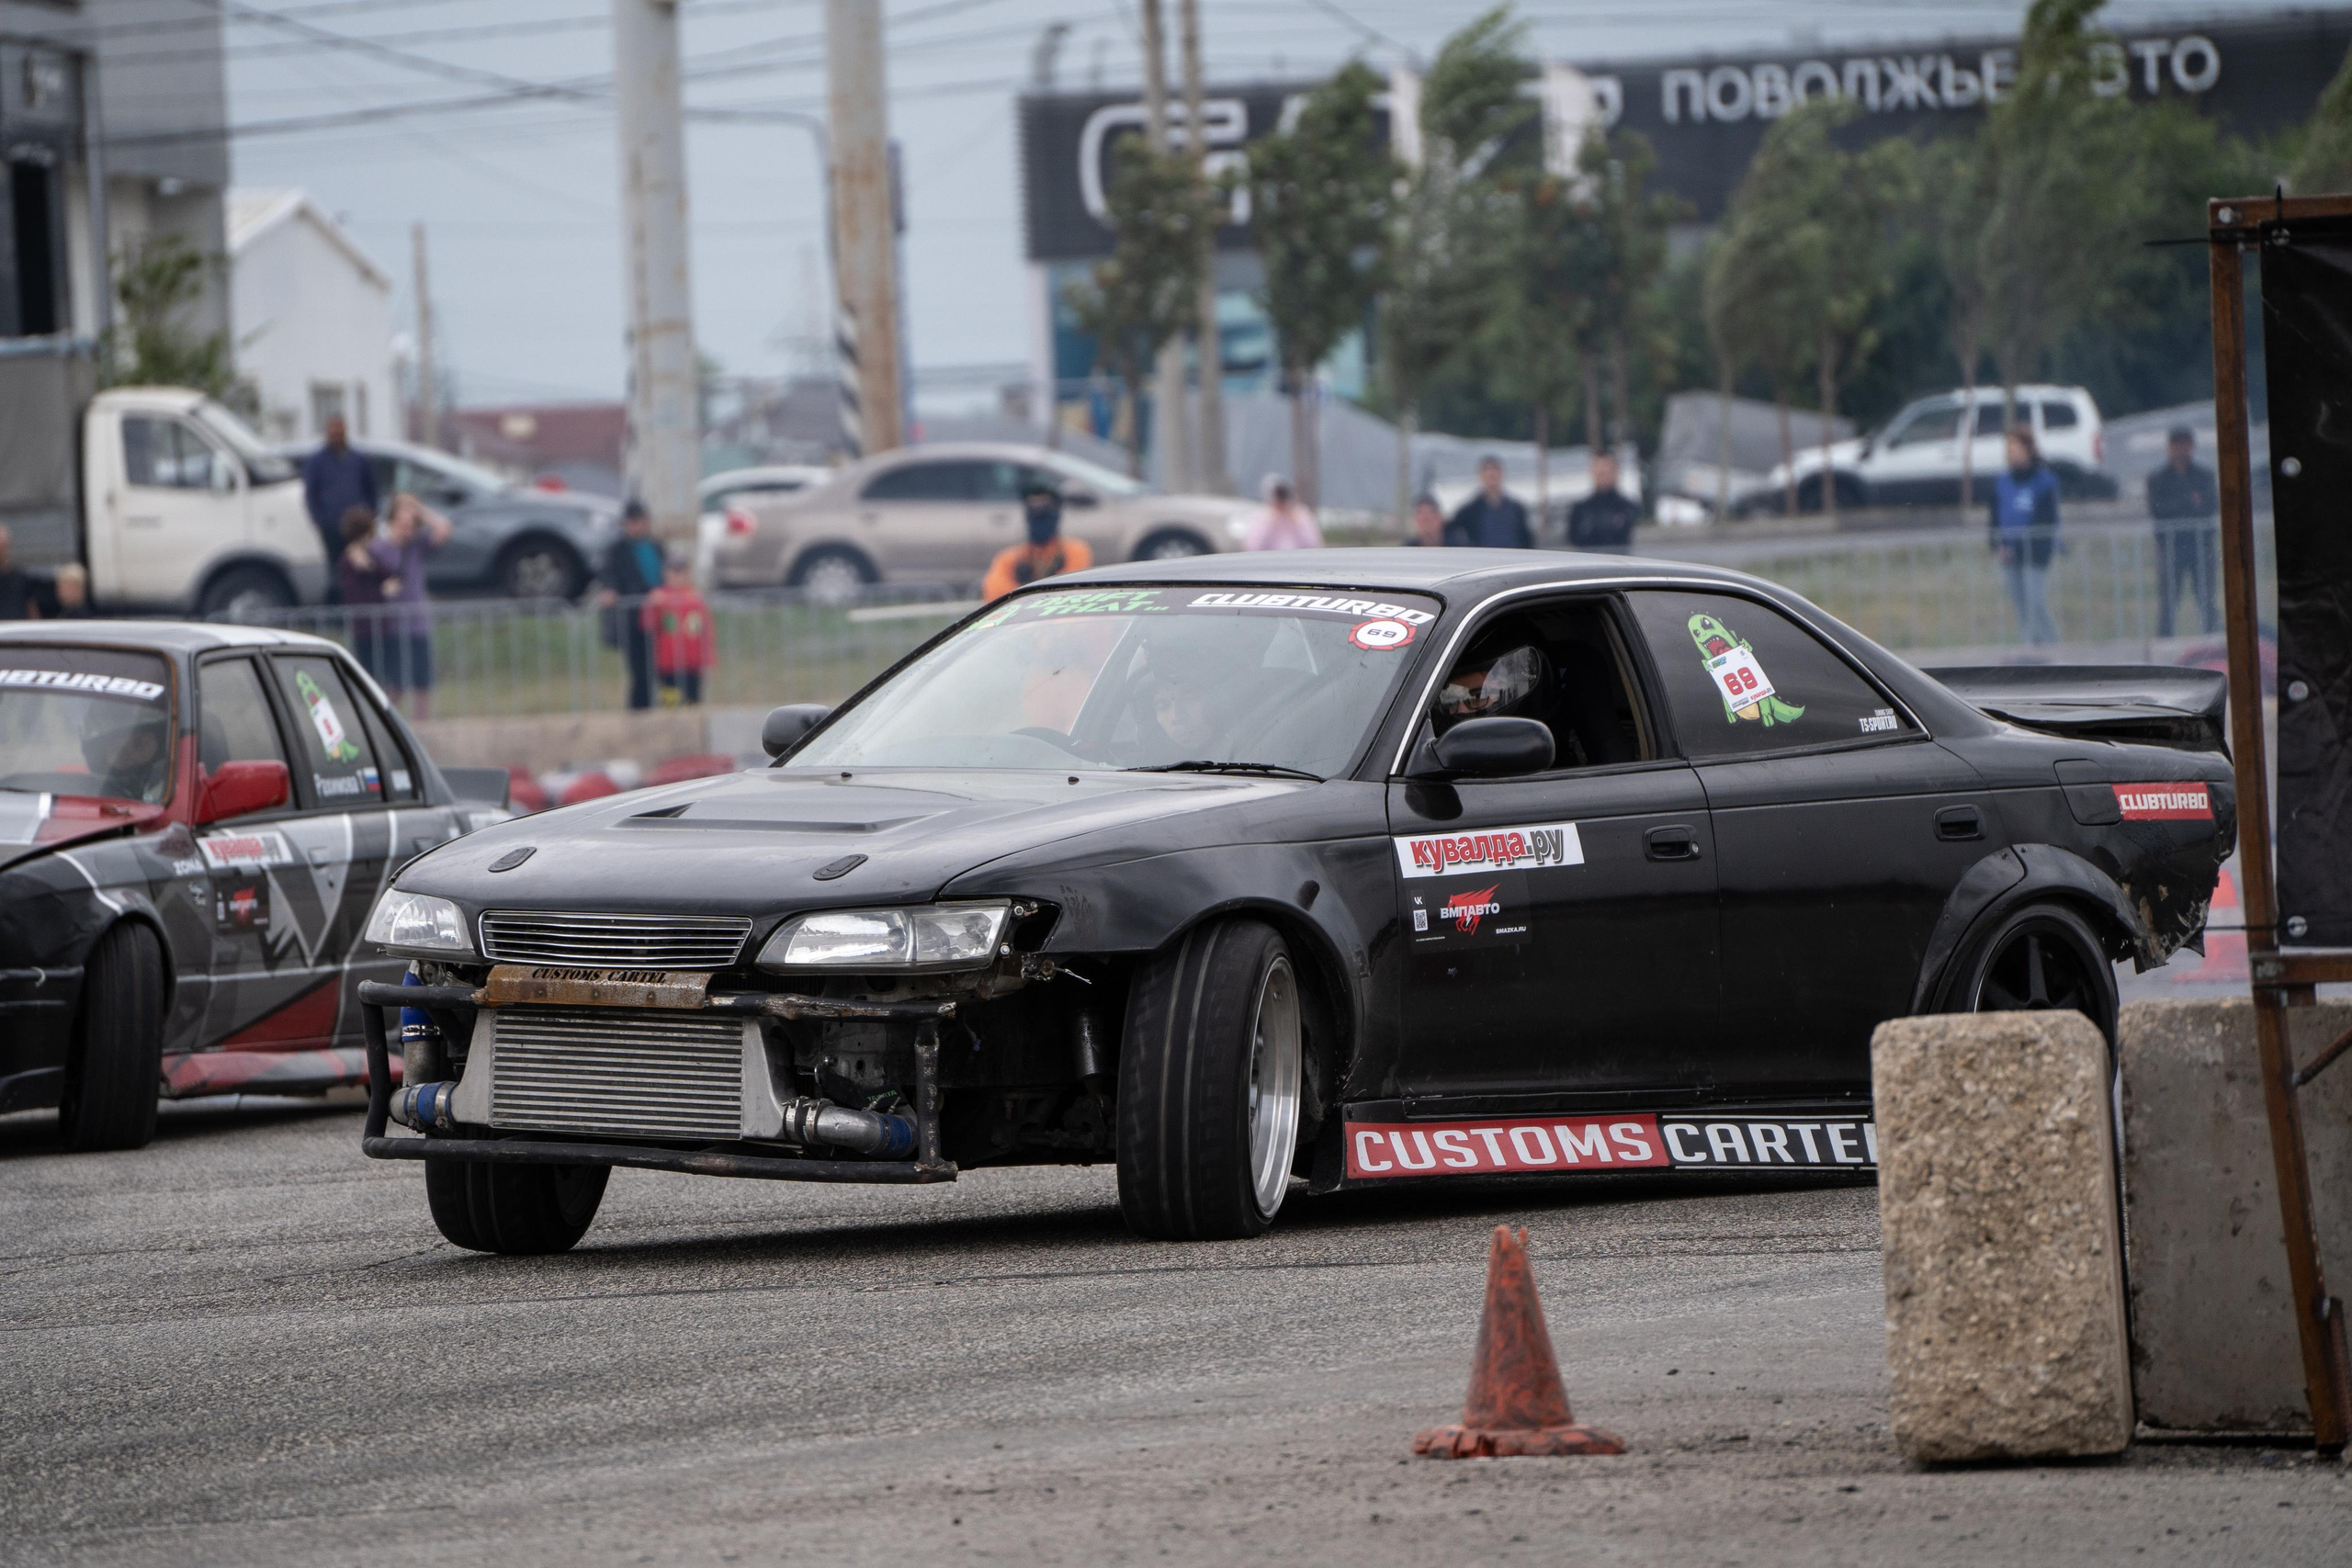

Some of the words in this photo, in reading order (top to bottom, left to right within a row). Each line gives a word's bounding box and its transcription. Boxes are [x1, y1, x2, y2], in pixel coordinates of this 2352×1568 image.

[1660, 48, 2018, 125] ПОВОЛЖЬЕ
[2043, 35, 2222, 98] ВТО
[1024, 591, 1162, 610] DRIFT
[1188, 592, 1436, 626] CLUBTURBO
[1366, 628, 1397, 638] 69
[1724, 667, 1758, 695] 69
[2120, 793, 2208, 810] CLUBTURBO
[1410, 829, 1563, 873] кувалда.ру
[1440, 902, 1500, 919] ВМПАВТО
[1495, 926, 1527, 934] SMAZKA.RU
[532, 967, 603, 981] CUSTOMS
[607, 970, 667, 983] CARTEL
[1355, 1122, 1654, 1172] CUSTOMS
